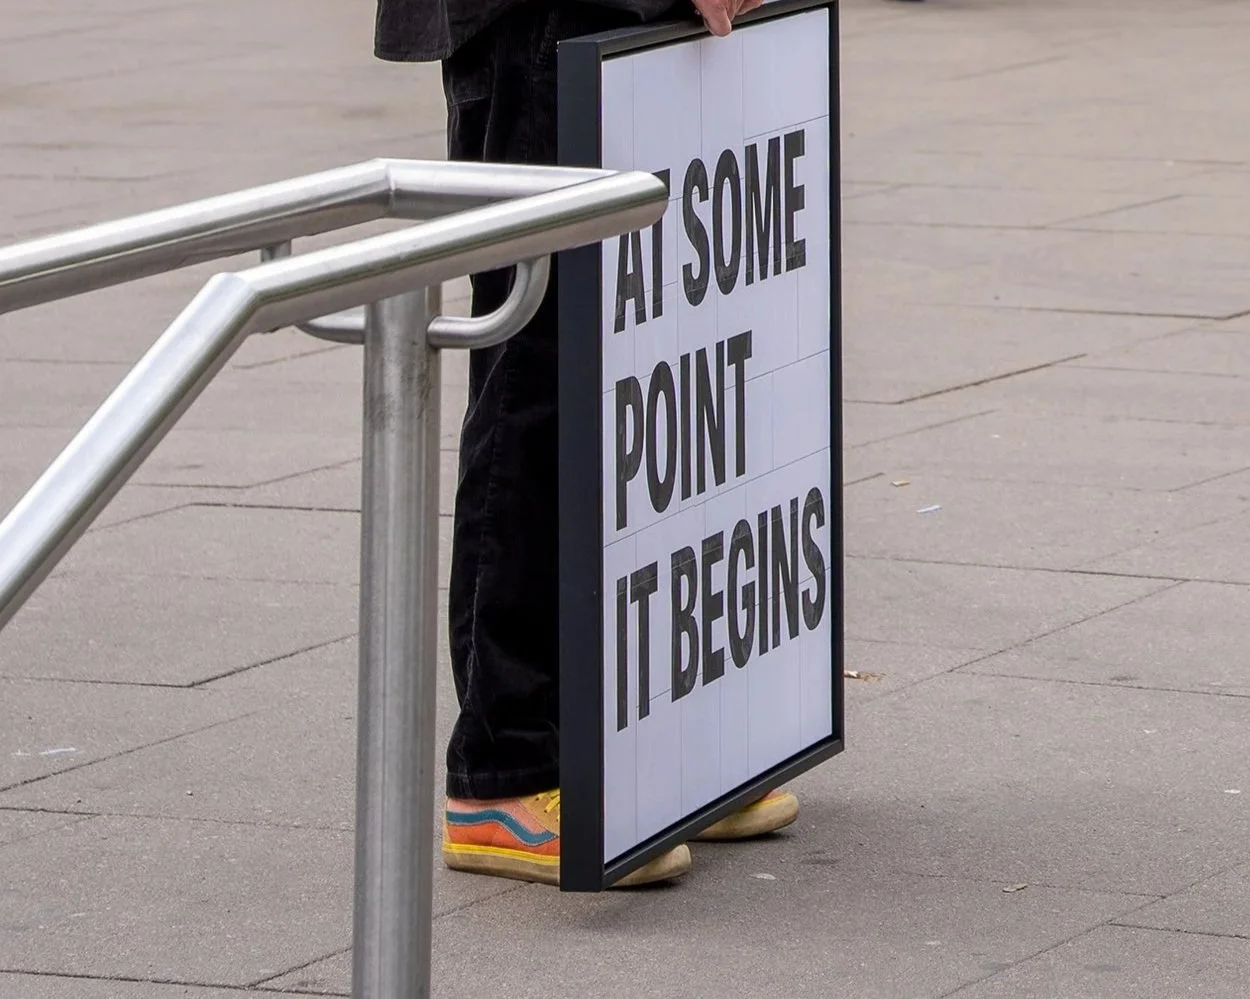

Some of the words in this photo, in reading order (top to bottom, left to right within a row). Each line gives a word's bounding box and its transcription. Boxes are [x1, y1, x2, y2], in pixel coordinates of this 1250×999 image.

[614, 168, 671, 334] AT
[682, 129, 806, 307] SOME
[615, 330, 752, 531] POINT
[616, 561, 658, 732] IT
[671, 486, 826, 702] BEGINS
